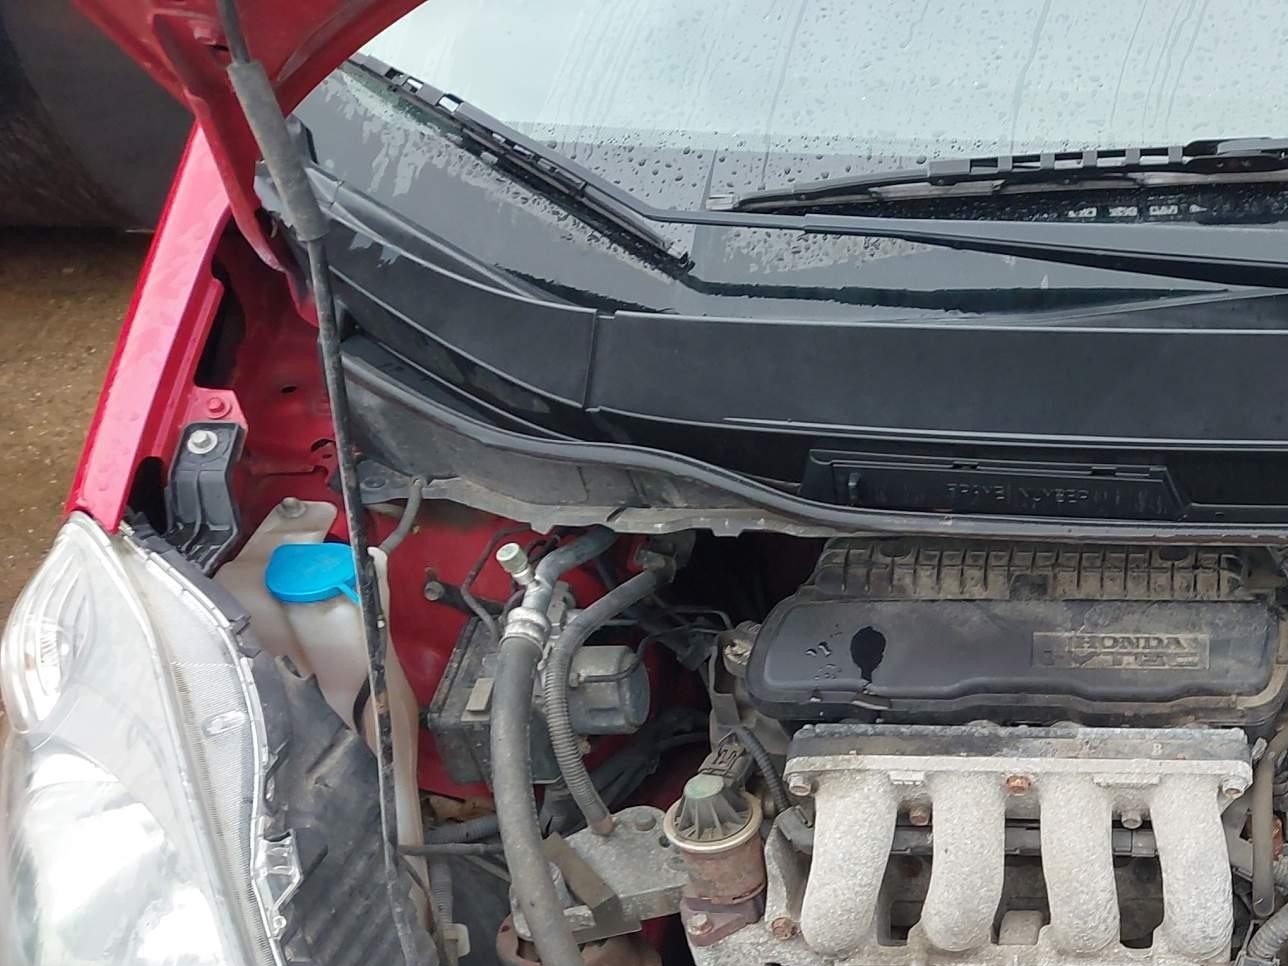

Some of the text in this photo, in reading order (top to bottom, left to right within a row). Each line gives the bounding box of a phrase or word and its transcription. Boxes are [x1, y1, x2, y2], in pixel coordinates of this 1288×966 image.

[947, 483, 1006, 501] FRAME
[1018, 486, 1089, 505] NUMBER
[1072, 635, 1188, 651] HONDA
